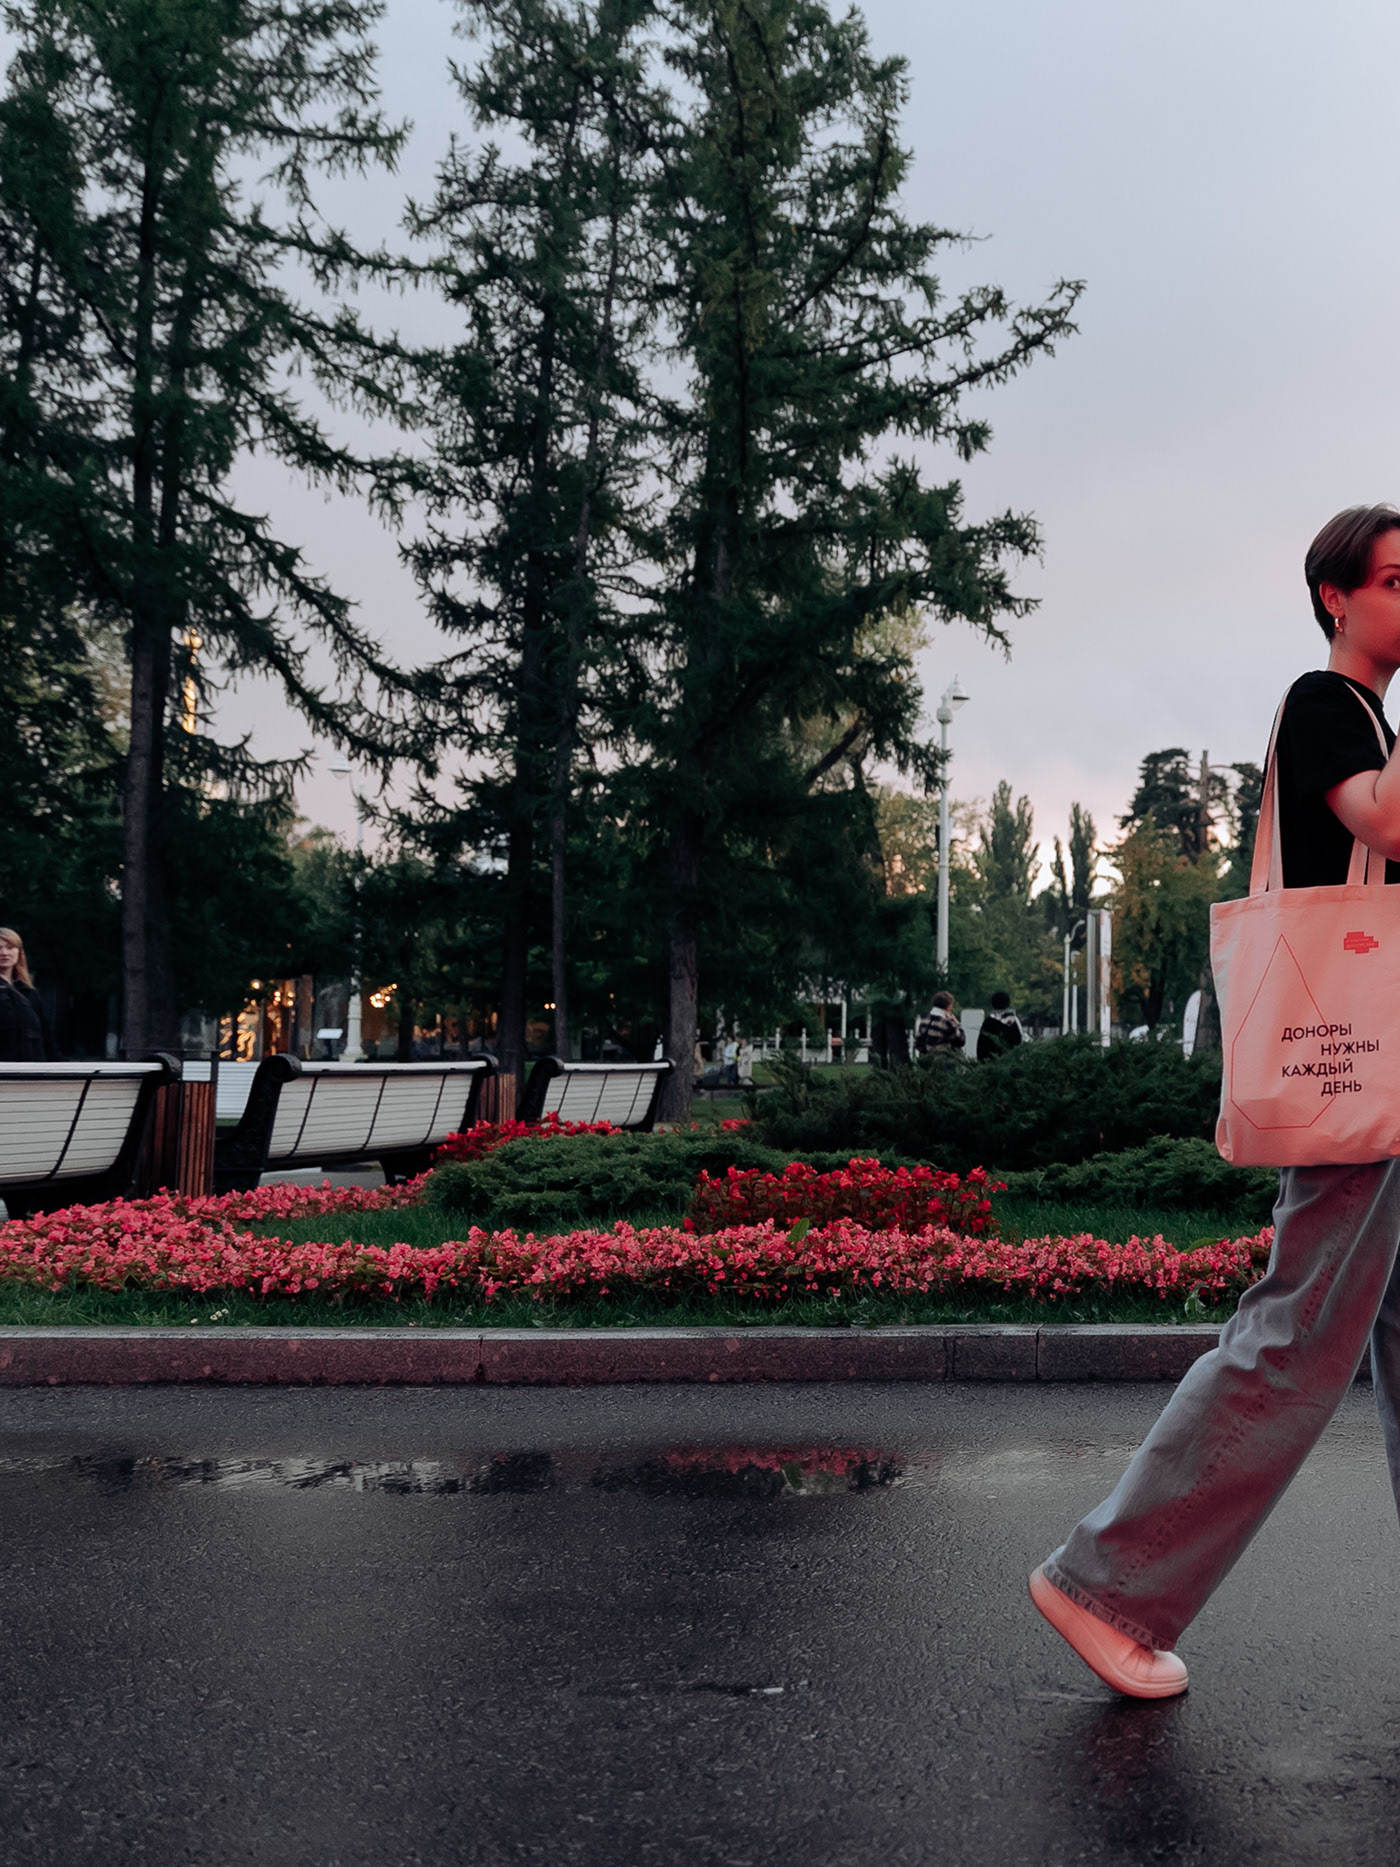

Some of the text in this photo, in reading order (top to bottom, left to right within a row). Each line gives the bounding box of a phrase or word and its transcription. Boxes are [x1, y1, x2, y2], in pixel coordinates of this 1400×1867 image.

[1281, 1023, 1352, 1043] ДОНОРЫ
[1321, 1039, 1379, 1056] НУЖНЫ
[1282, 1058, 1353, 1078] КАЖДЫЙ
[1321, 1080, 1362, 1097] ДЕНЬ
